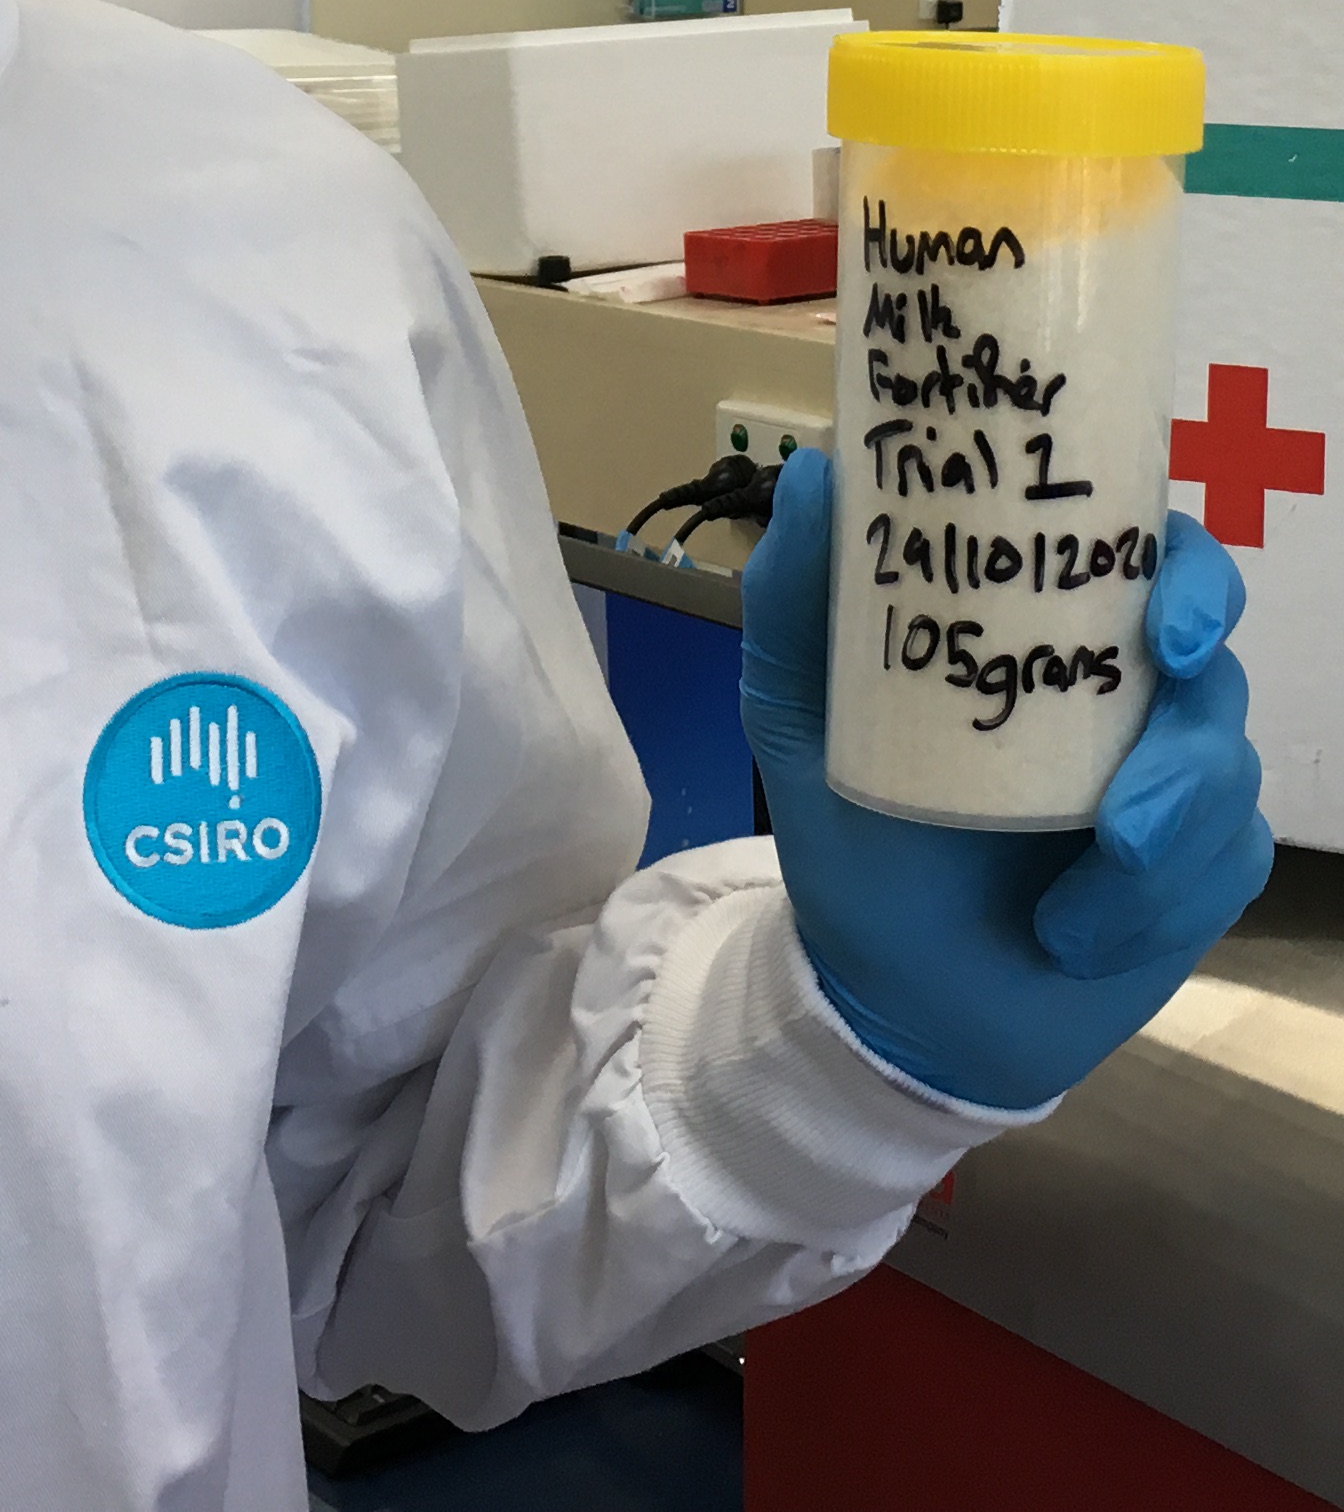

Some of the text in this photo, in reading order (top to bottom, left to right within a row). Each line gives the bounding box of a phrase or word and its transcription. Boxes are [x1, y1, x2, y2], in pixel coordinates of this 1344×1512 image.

[863, 196, 1026, 275] Human
[864, 284, 961, 344] Milk
[864, 418, 997, 494] Trial
[884, 604, 1122, 731] 105grams
[124, 817, 291, 869] CSIRO
